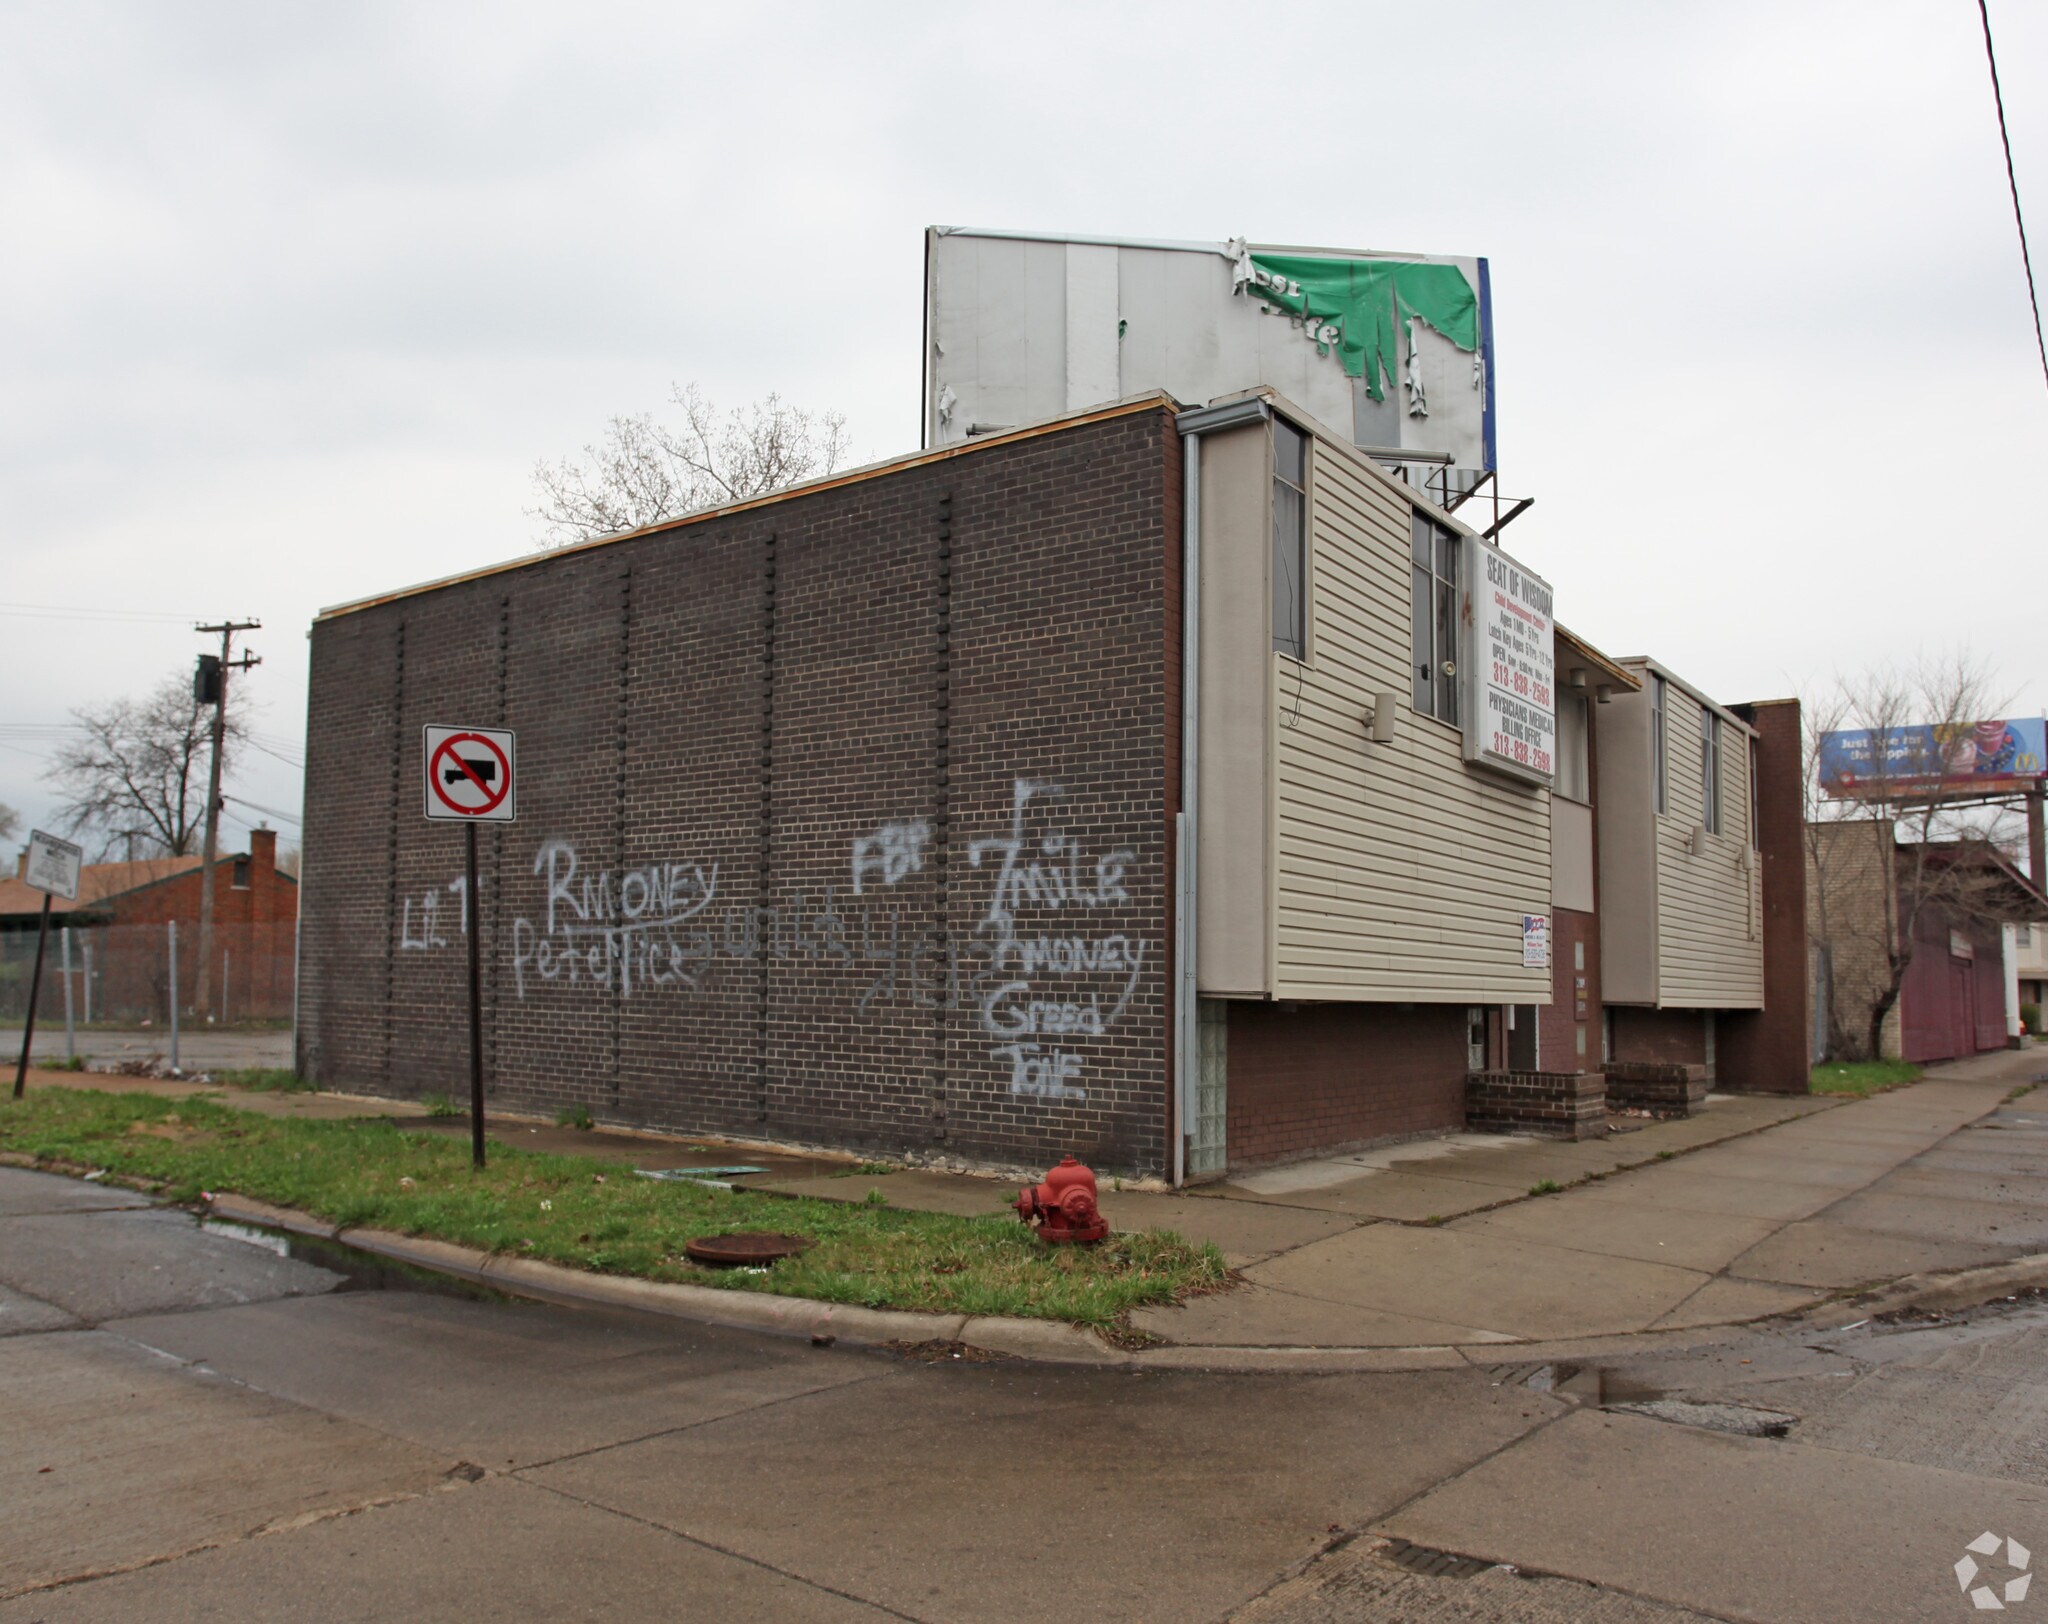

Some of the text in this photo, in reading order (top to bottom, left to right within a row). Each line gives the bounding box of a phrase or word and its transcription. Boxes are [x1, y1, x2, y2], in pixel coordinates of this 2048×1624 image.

[1487, 554, 1552, 620] SEAT OF WISDOM
[1501, 610, 1512, 629] Ages
[1489, 621, 1501, 641] Latch
[1503, 630, 1511, 648] Key
[1513, 635, 1523, 653] Ages
[1493, 643, 1505, 662] OPEN
[1489, 691, 1553, 736] PHYSICIANS MEDICAL
[1502, 716, 1541, 749] BILLING OFFICE
[1842, 737, 1867, 749] Just
